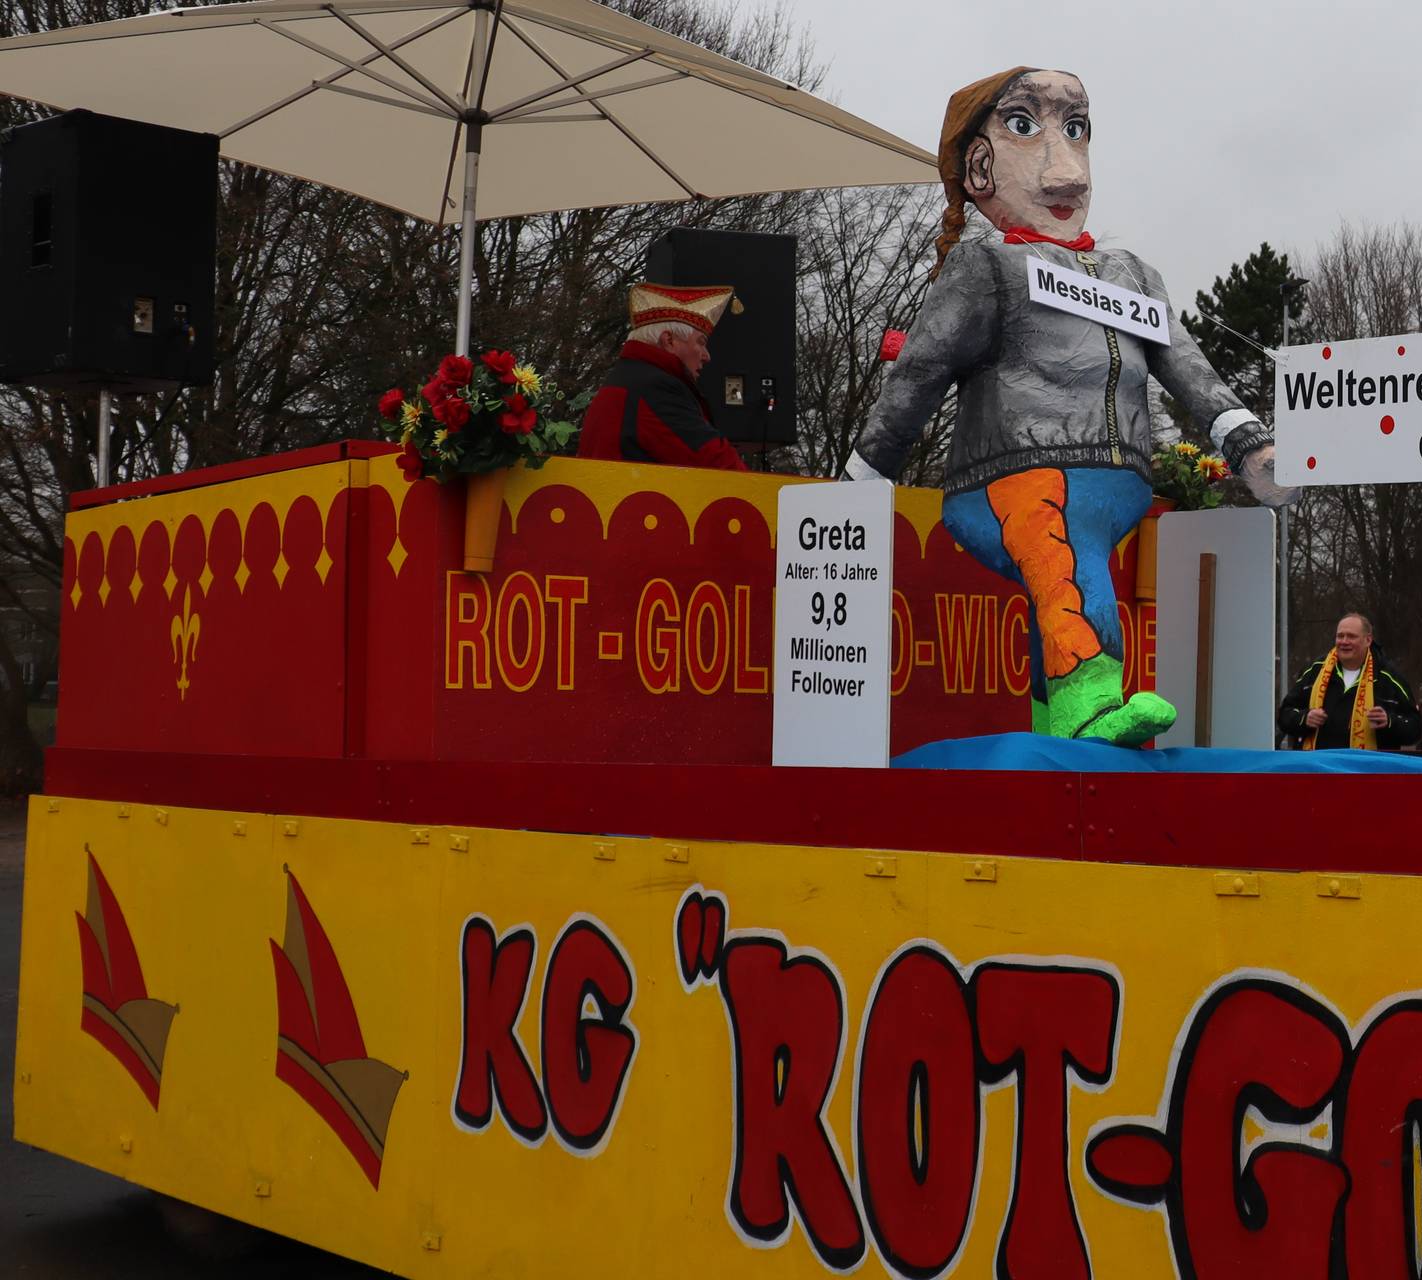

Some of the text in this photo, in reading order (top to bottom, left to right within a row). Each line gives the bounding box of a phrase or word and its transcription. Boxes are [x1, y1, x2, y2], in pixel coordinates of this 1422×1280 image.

[1036, 267, 1160, 329] Messias 2.0
[798, 517, 865, 551] Greta
[785, 562, 878, 581] Alter: 16 Jahre
[811, 591, 847, 631] 9,8
[790, 637, 867, 664] Millionen
[791, 670, 865, 697] Follower
[451, 913, 637, 1157] KG
